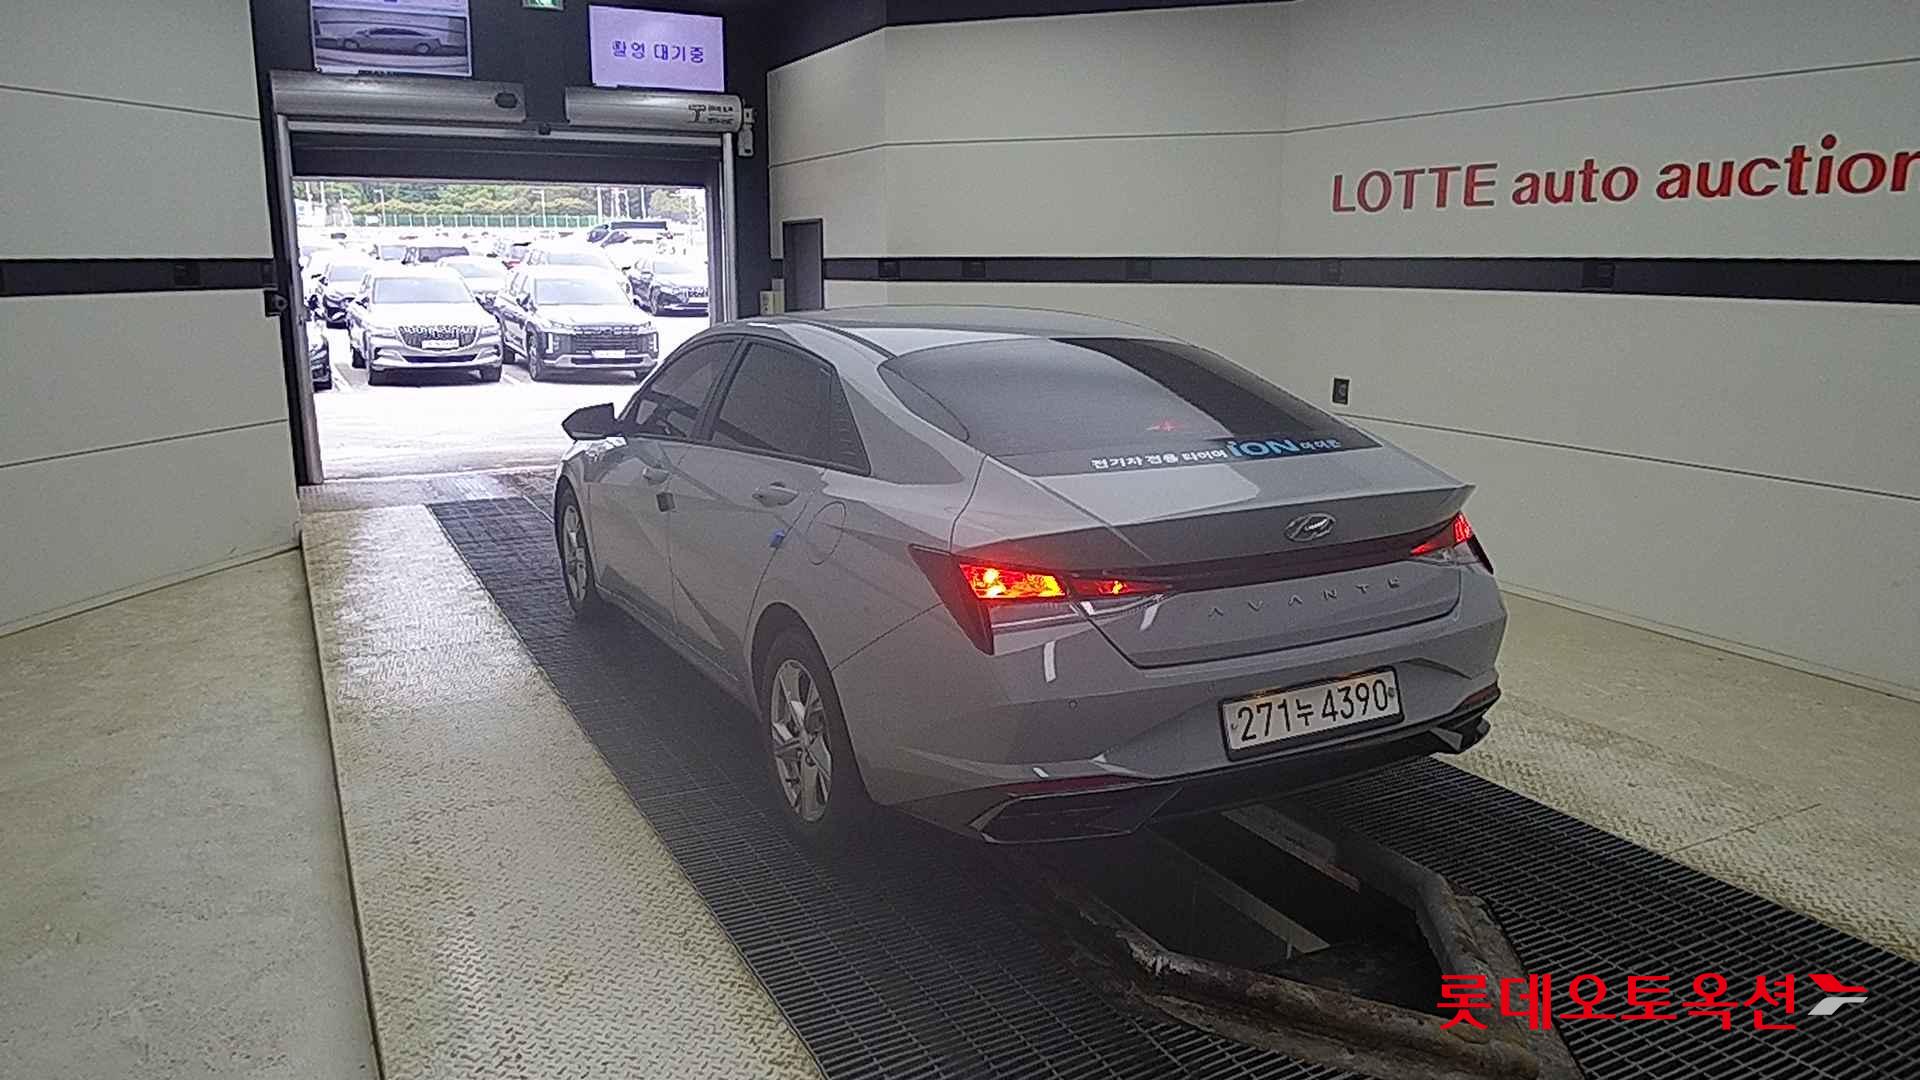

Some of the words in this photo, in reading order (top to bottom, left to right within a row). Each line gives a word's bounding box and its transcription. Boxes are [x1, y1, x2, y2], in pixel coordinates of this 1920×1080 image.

[653, 43, 705, 64] 대기중
[1332, 162, 1498, 213] LOTTE
[1511, 157, 1639, 206] auto
[1090, 456, 1143, 470] 전기차
[1144, 453, 1179, 465] 전용
[1227, 439, 1300, 457] iON
[1208, 575, 1400, 618] AVANTE
